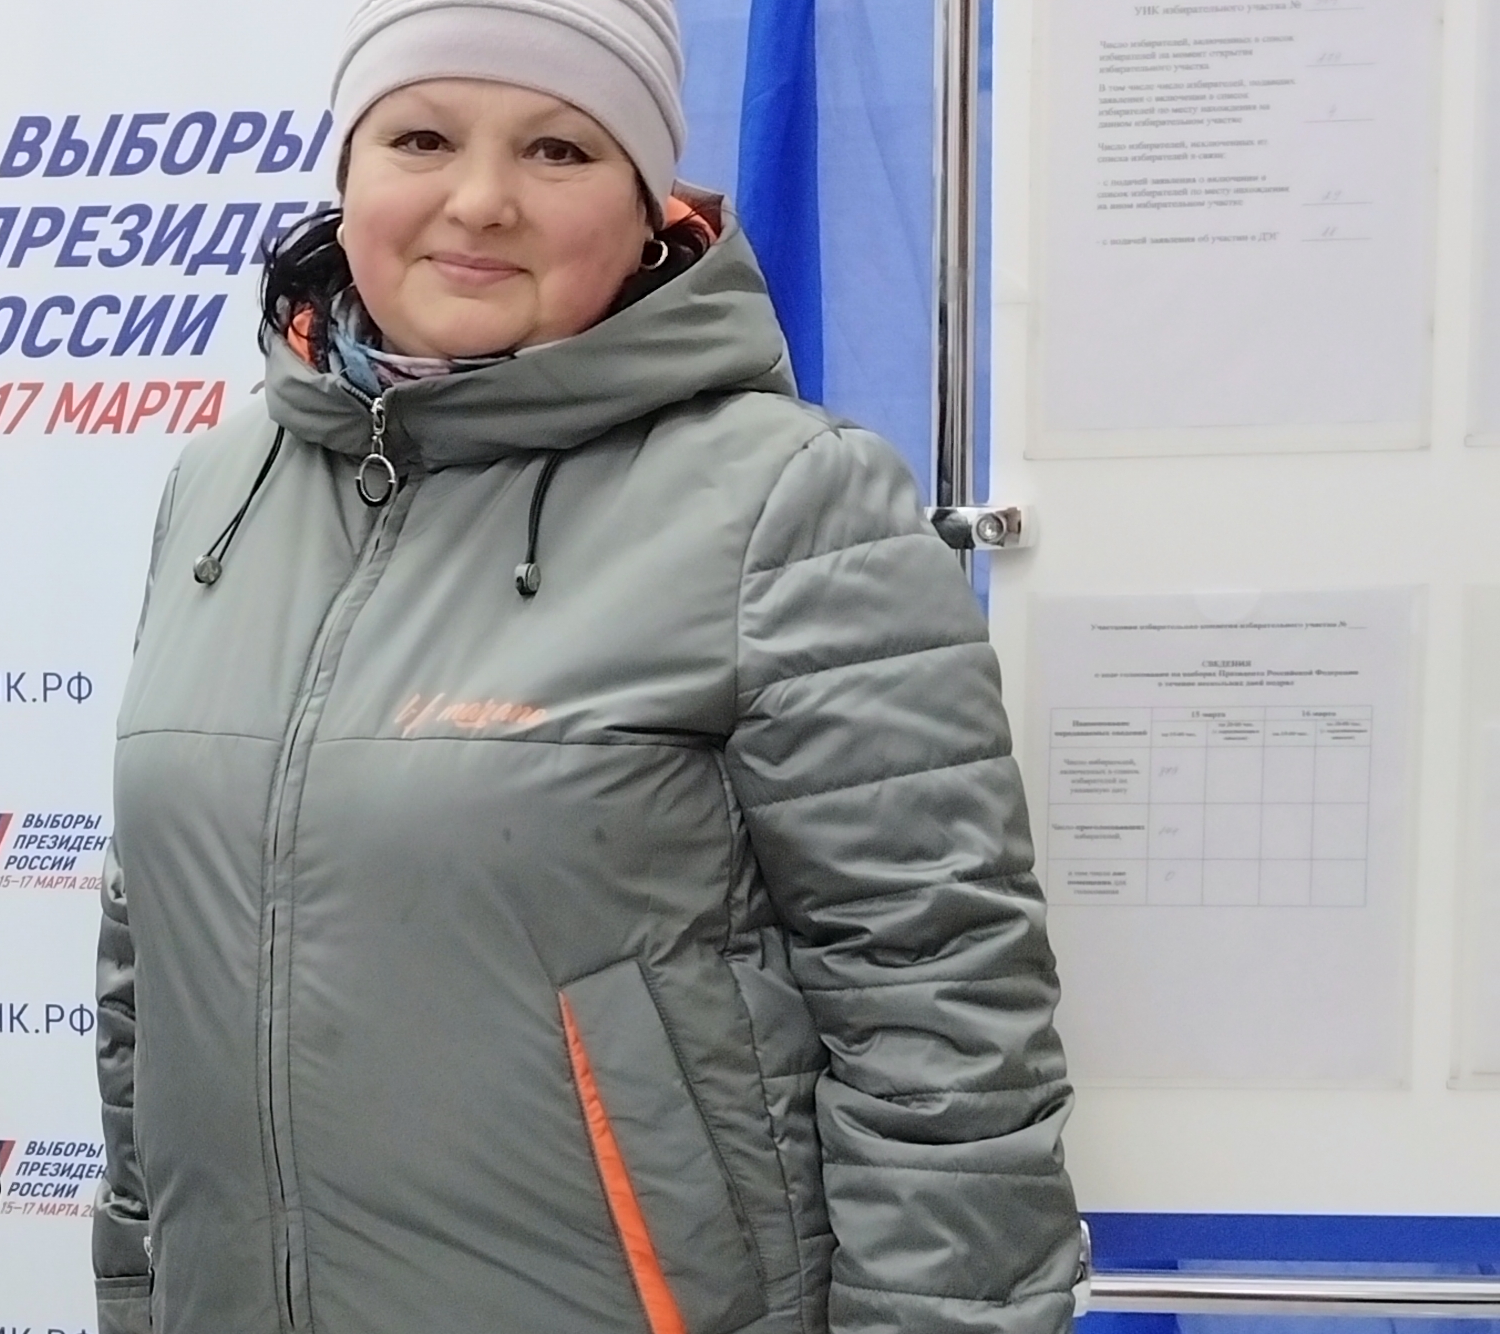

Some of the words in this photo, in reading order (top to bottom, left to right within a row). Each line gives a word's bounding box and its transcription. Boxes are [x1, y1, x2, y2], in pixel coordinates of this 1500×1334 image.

[43, 381, 224, 435] МАРТА
[21, 813, 102, 829] ВЫБОРЫ
[12, 834, 111, 852] ПРЕЗИДЕН
[4, 855, 77, 871] РОССИИ
[33, 875, 77, 889] МАРТА
[79, 877, 103, 890] 202
[24, 1141, 104, 1158] ВЫБОРЫ
[16, 1161, 107, 1180] ПРЕЗИДЕН
[7, 1182, 79, 1198] РОССИИ
[36, 1202, 79, 1217] МАРТА
